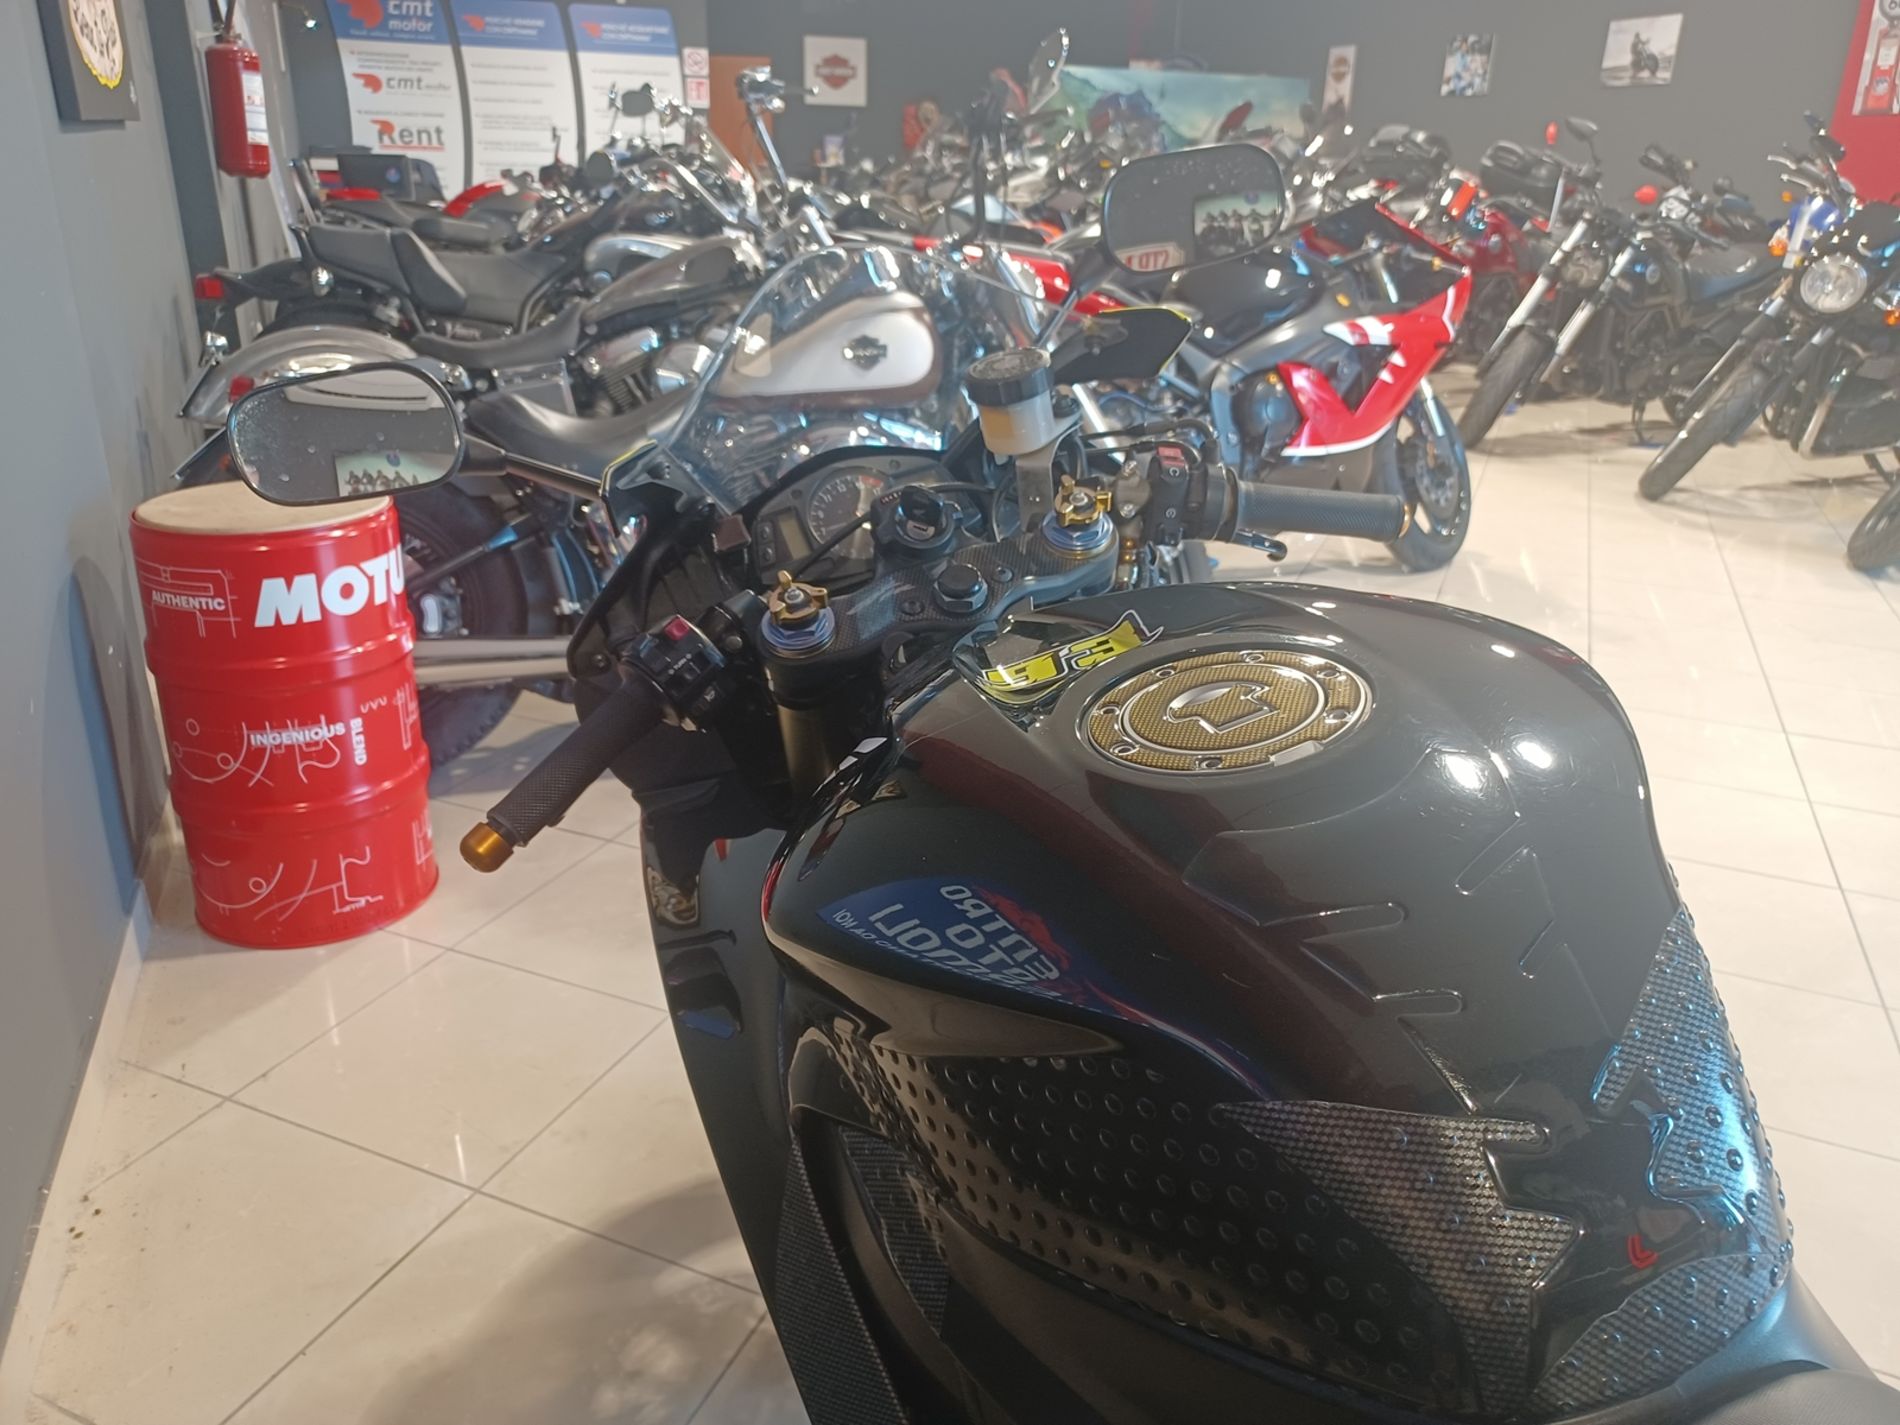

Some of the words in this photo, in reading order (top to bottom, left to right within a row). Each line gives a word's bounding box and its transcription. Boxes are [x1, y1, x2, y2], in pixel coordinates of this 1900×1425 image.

[387, 0, 434, 17] cmt
[388, 19, 434, 32] motor
[385, 76, 424, 90] cmt
[375, 119, 445, 146] Rent
[254, 543, 405, 628] MOTU
[152, 590, 226, 611] AUTHENTIC
[250, 722, 346, 747] INGENIOUS
[351, 717, 367, 766] BLEND
